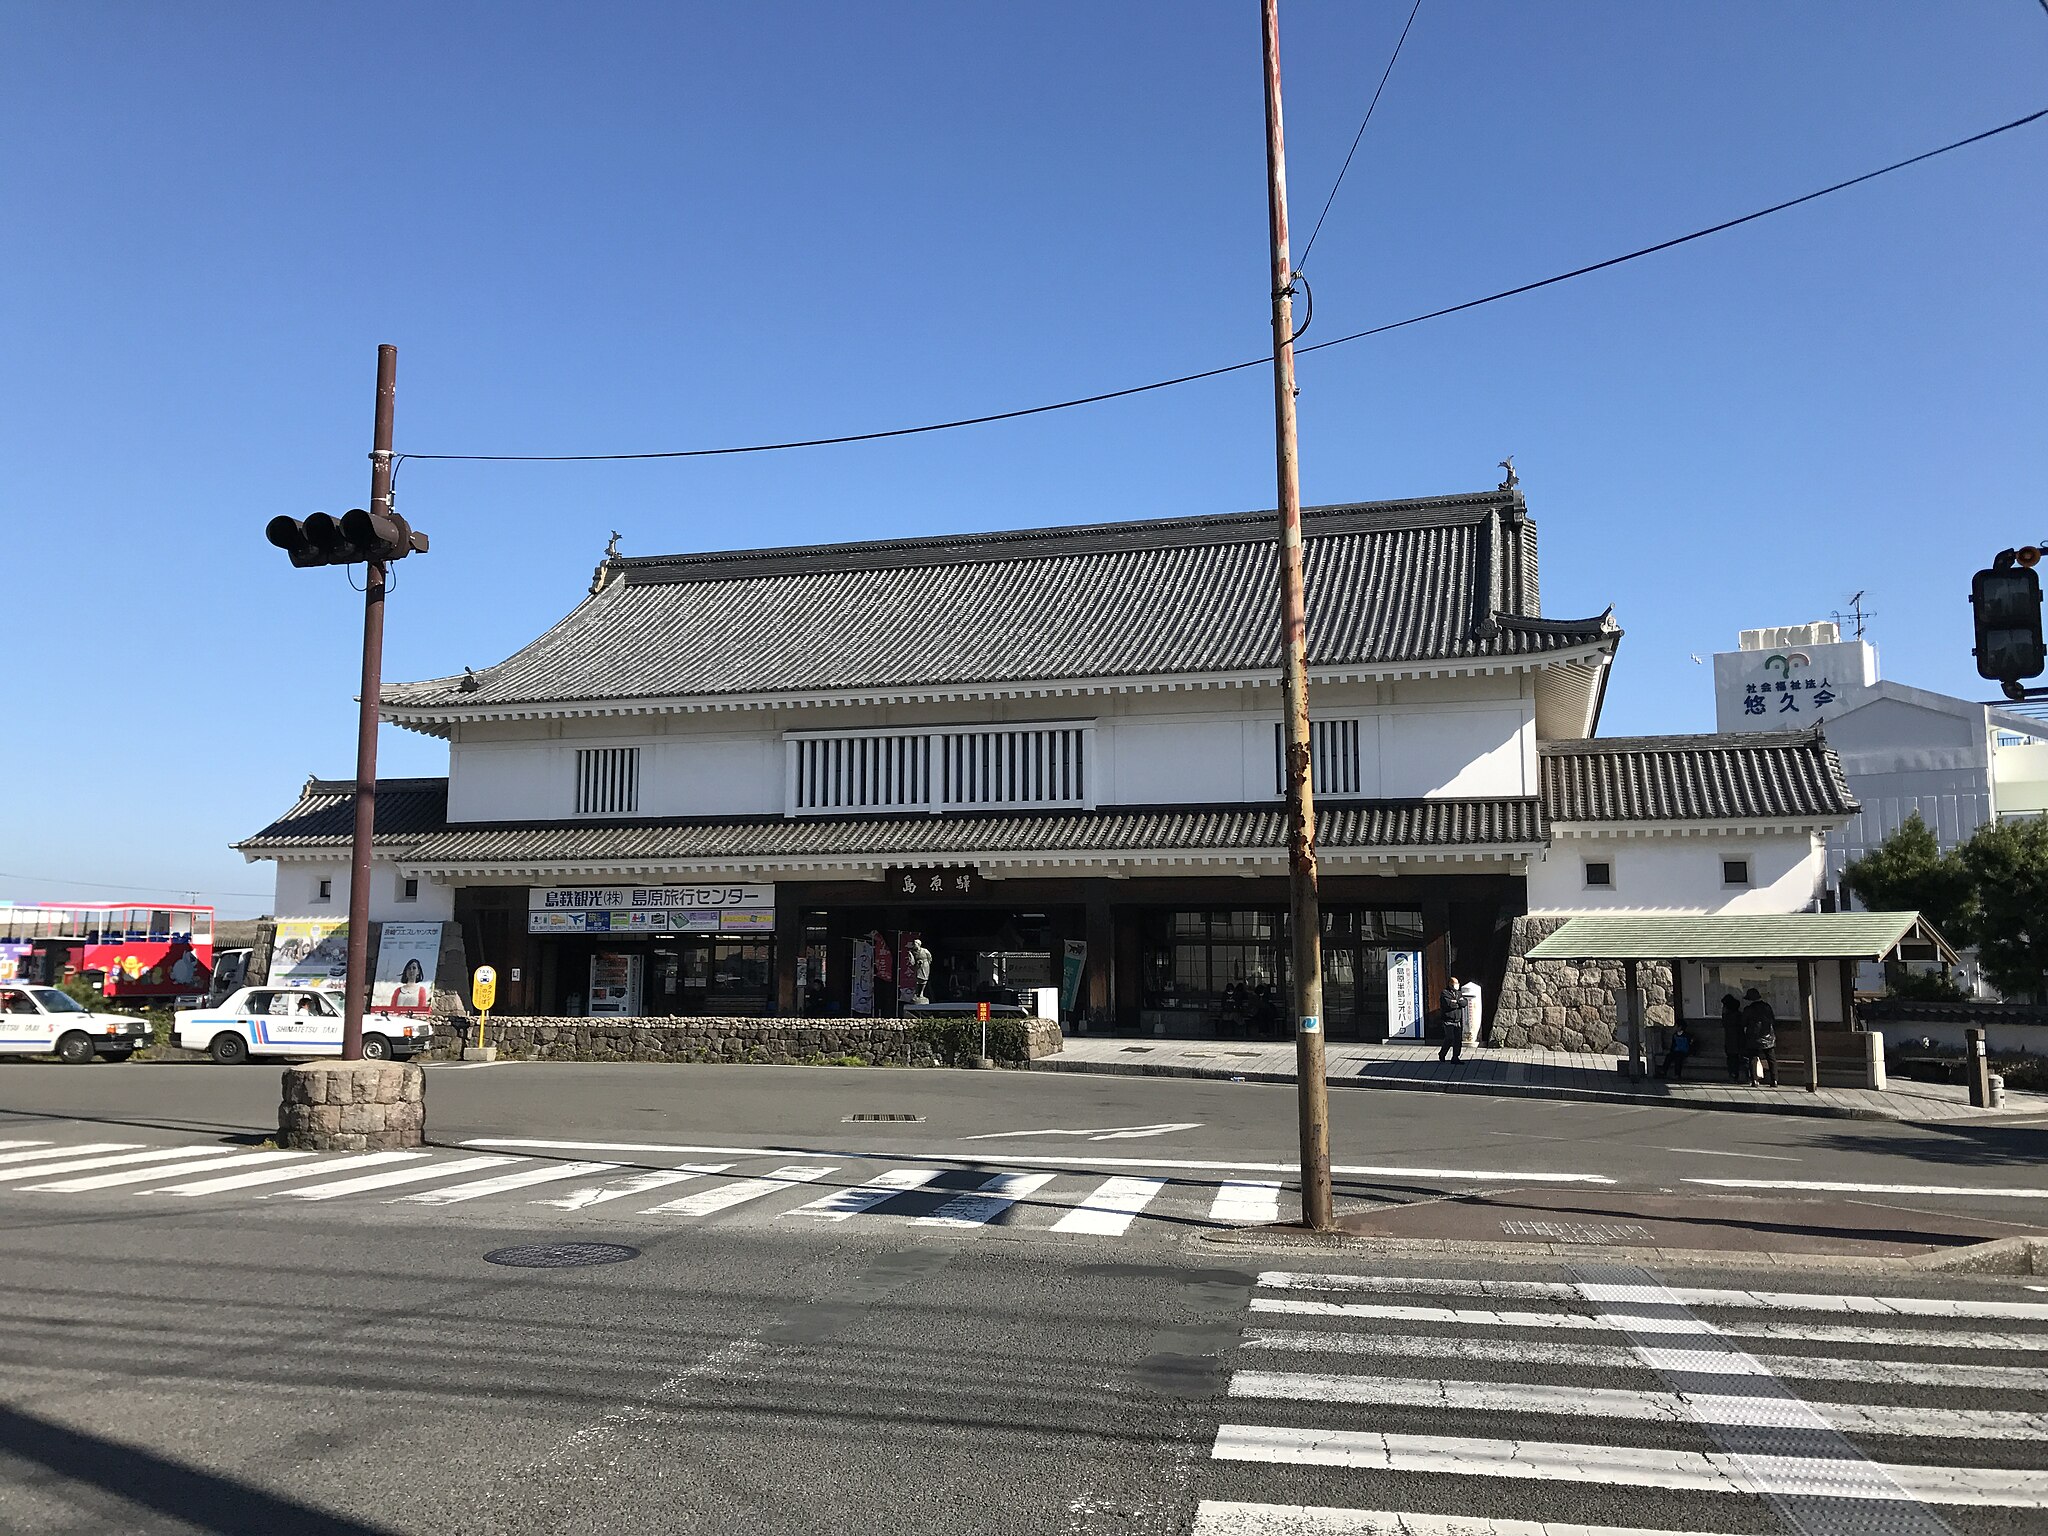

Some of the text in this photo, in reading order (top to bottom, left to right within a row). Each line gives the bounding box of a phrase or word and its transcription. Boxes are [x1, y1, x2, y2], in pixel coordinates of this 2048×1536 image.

[1746, 677, 1832, 694] 社会福祉法人
[1743, 690, 1836, 715] 悠久会
[631, 888, 759, 906] 島原旅行センター
[383, 928, 439, 936] 長崎ウエスレヤン大学
[1396, 967, 1406, 1035] 島原半島ジオパーク
[275, 1025, 339, 1034] SHIMATETSU TAXI
